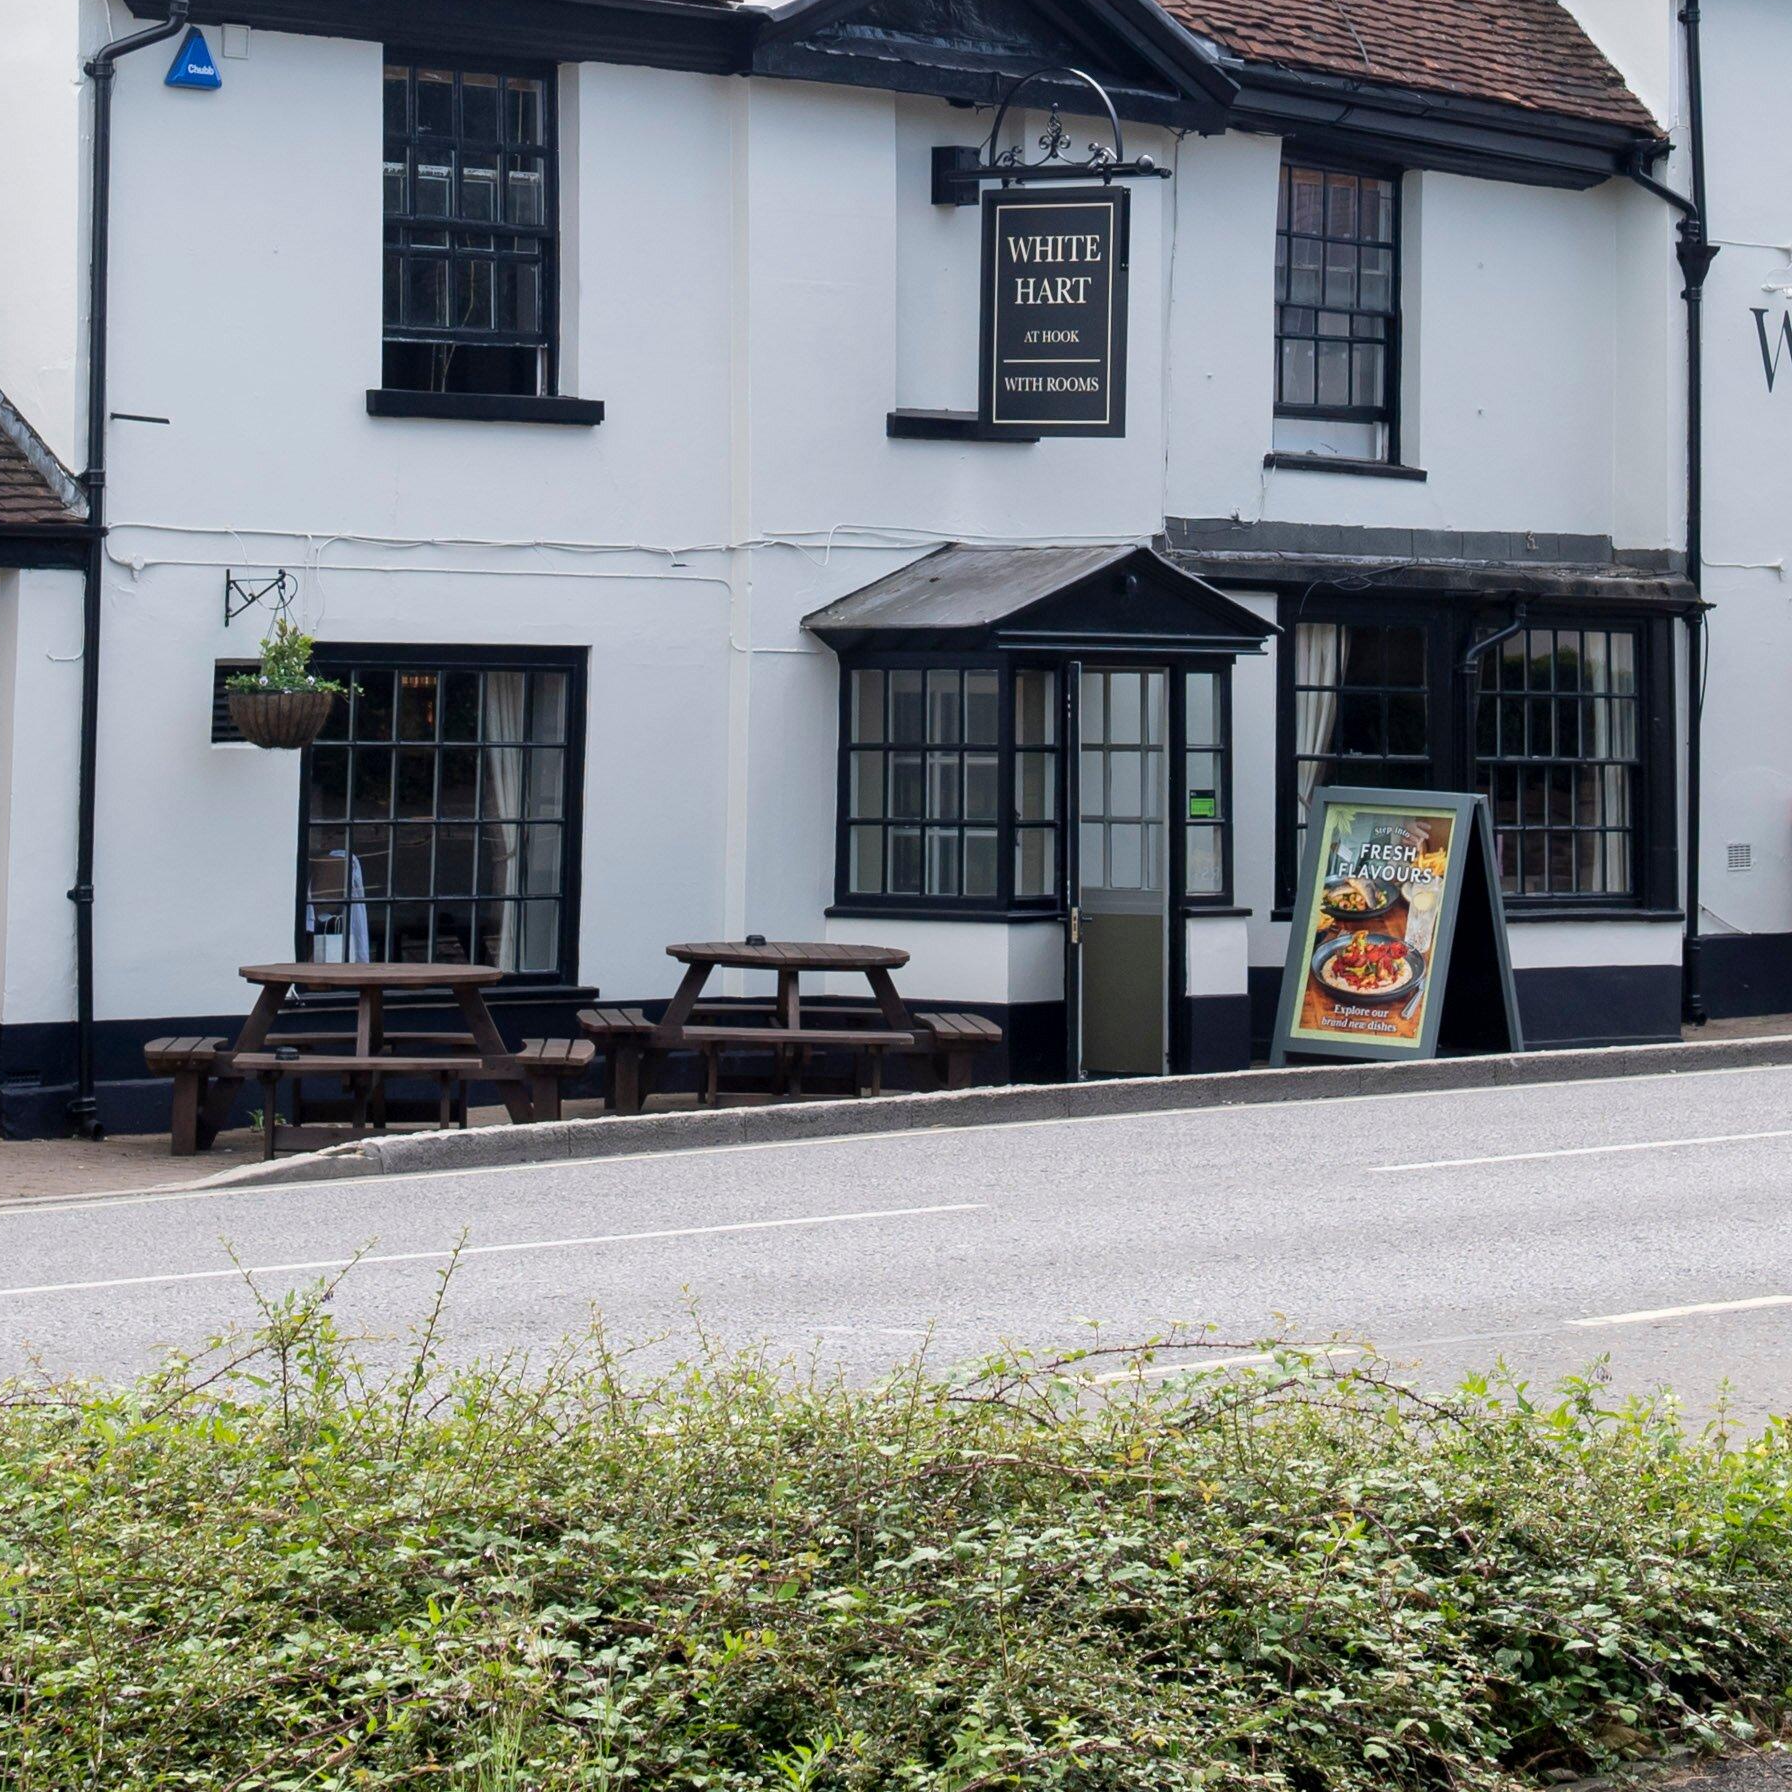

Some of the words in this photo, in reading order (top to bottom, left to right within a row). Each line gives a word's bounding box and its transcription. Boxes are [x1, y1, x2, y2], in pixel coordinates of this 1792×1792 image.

[187, 63, 215, 76] Chubb
[1007, 234, 1101, 263] WHITE
[1014, 276, 1092, 305] HART
[1024, 330, 1040, 343] AT
[1042, 330, 1080, 343] HOOK
[1004, 377, 1044, 392] WITH
[1046, 376, 1099, 392] ROOMS
[1374, 826, 1392, 836] Step
[1394, 825, 1410, 838] into
[1360, 843, 1417, 862] FRESH
[1338, 862, 1432, 884] FLAVOURS
[1334, 1004, 1370, 1017] Explore
[1371, 1009, 1389, 1018] our
[1321, 1016, 1348, 1028] brand
[1348, 1021, 1367, 1029] new
[1367, 1020, 1397, 1032] dishes
